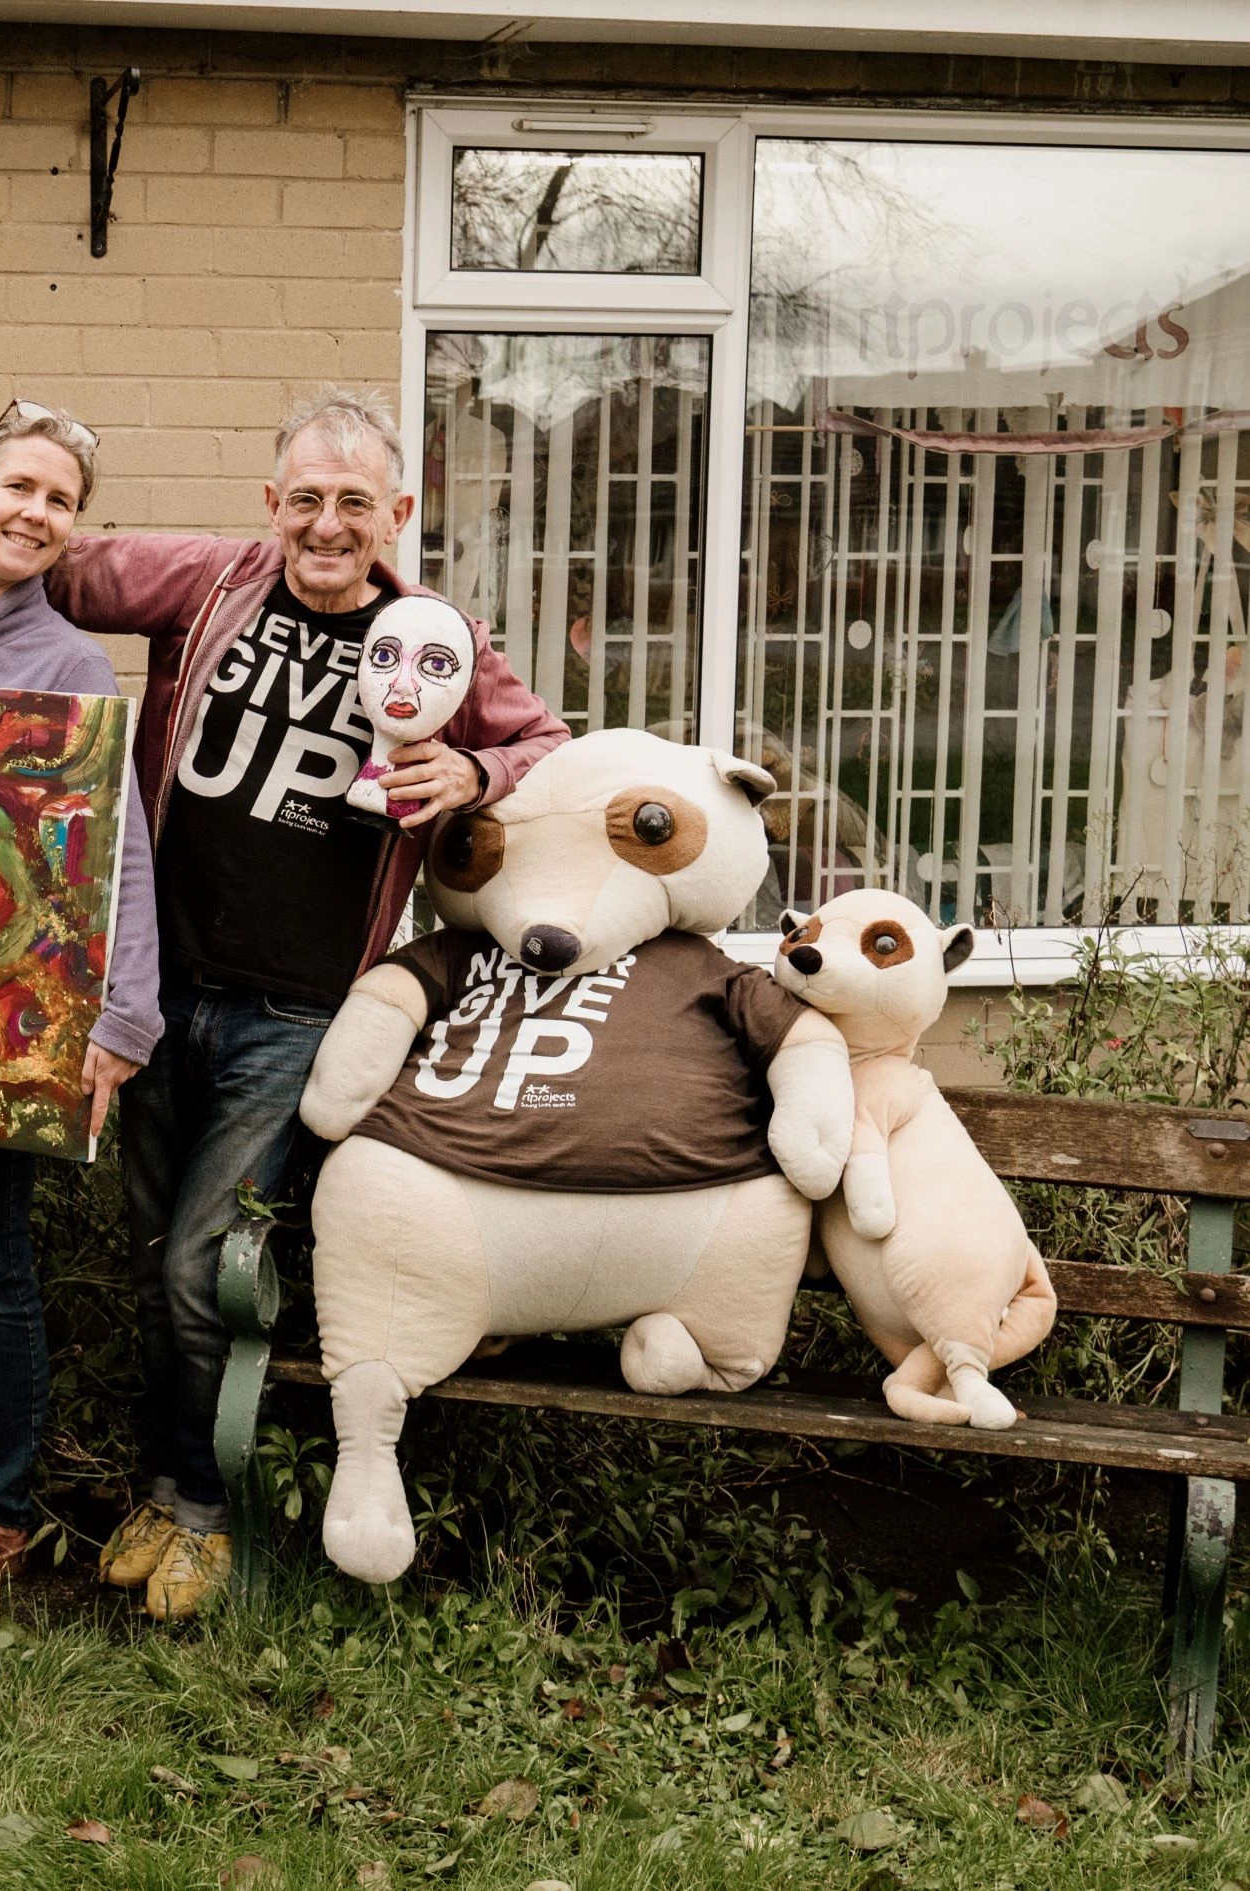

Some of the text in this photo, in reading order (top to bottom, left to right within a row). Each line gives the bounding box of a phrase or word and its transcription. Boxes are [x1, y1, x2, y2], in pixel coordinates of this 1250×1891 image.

[858, 287, 1190, 381] rtprojects
[243, 606, 363, 675] EVE
[177, 693, 360, 823] UP
[280, 808, 329, 830] rtprojects
[465, 947, 637, 987] NER
[449, 975, 627, 1026] GIVE
[414, 1017, 594, 1111] UP
[521, 1093, 576, 1104] rtprojects
